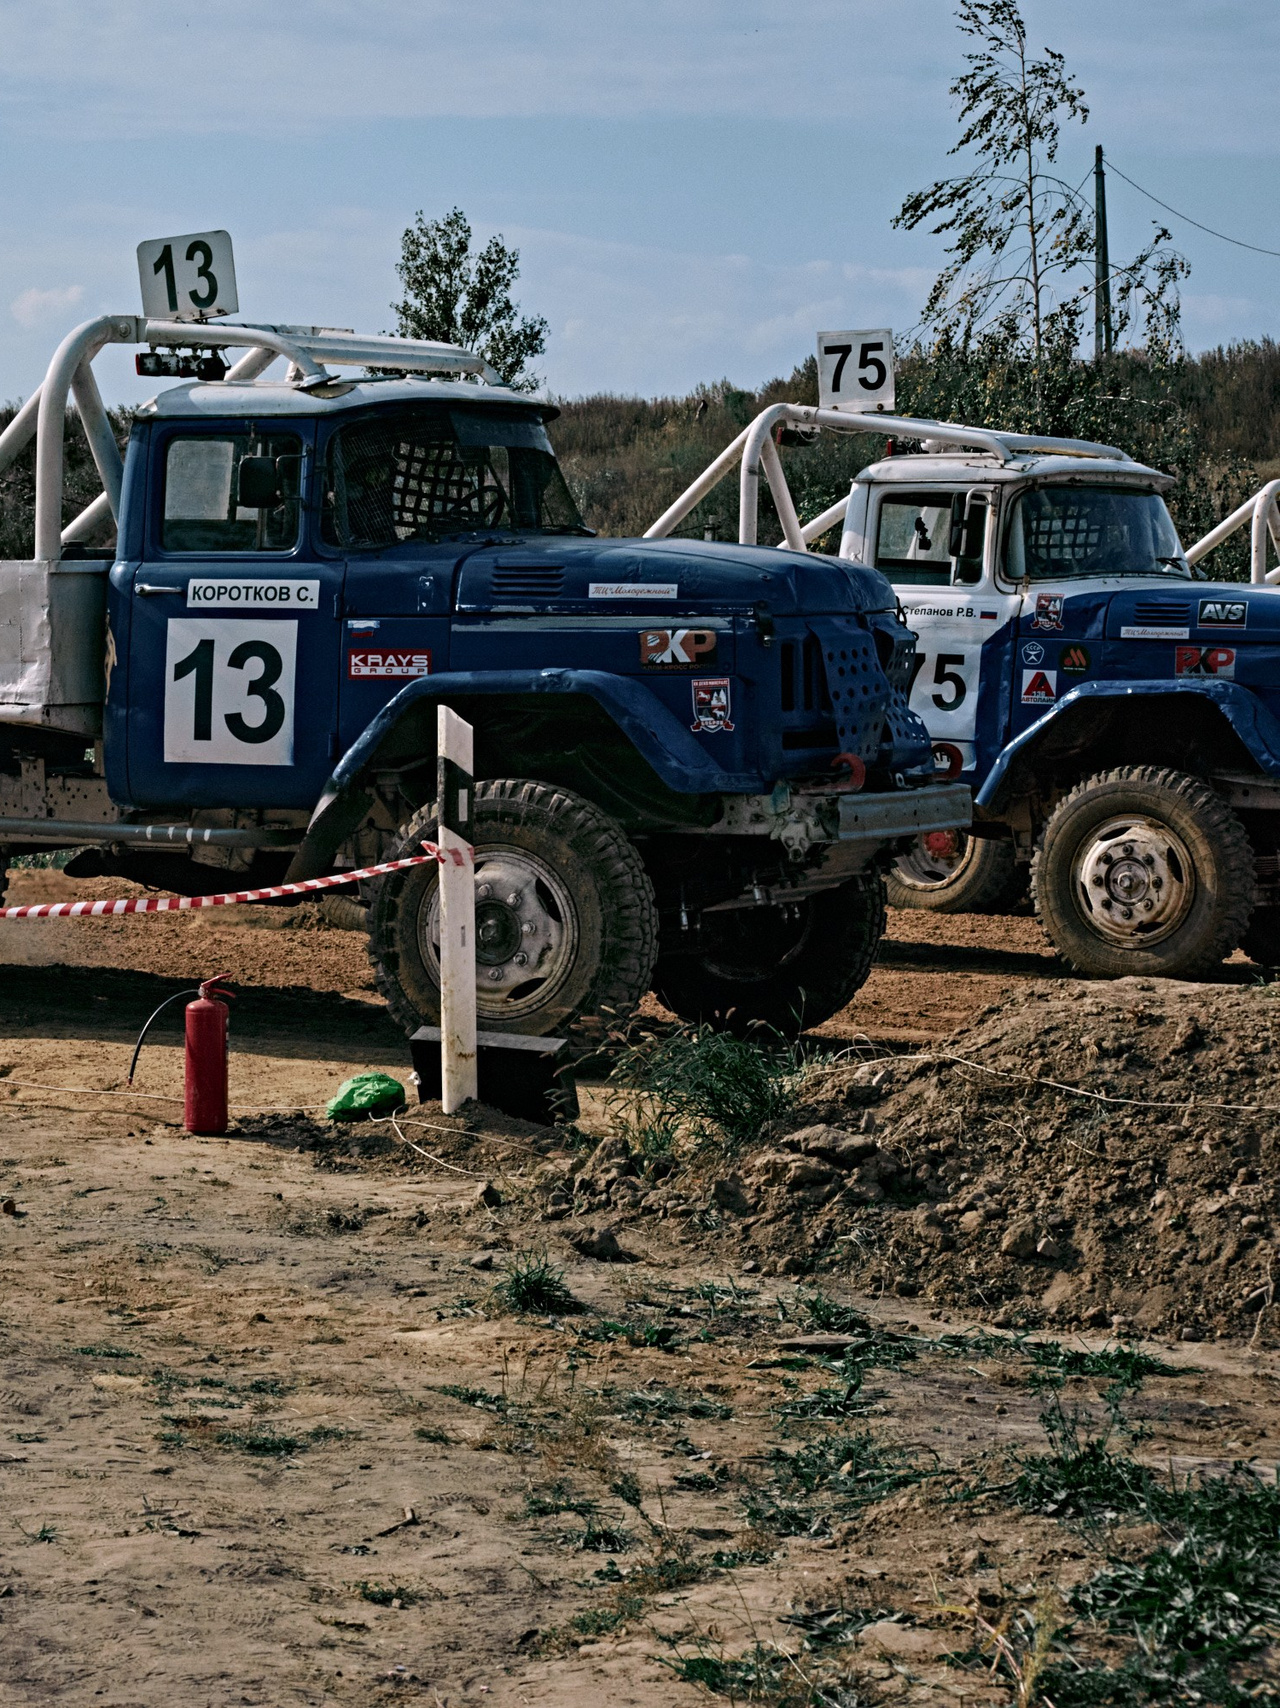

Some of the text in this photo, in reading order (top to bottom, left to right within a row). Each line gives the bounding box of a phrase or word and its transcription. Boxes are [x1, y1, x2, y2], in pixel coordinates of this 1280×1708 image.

[153, 240, 219, 313] 13
[823, 341, 887, 393] 75
[192, 585, 314, 602] КОРОТКОВ С.
[903, 605, 977, 618] Степанов Р.В.
[1200, 603, 1245, 620] AVS
[351, 654, 429, 666] KRAYS
[173, 638, 286, 744] 13
[907, 653, 967, 711] 75
